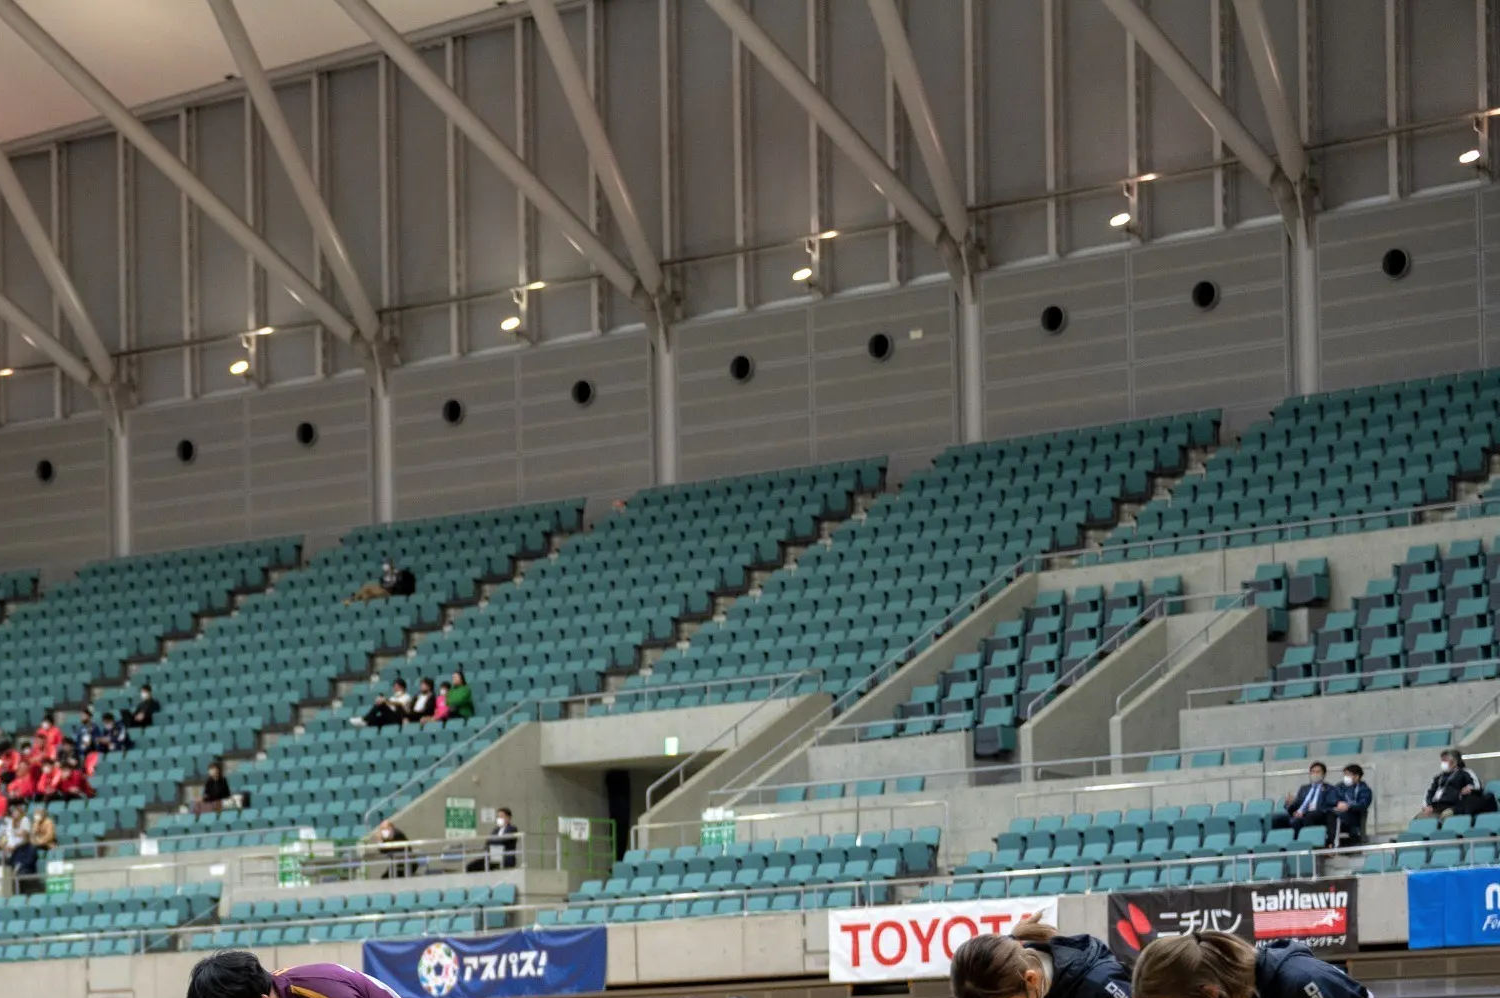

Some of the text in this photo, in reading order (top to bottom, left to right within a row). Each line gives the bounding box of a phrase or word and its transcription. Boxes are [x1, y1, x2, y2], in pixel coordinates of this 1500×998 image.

[1251, 884, 1348, 912] battlewin
[1157, 909, 1243, 938] ニチバン
[840, 912, 1034, 967] TOYOT
